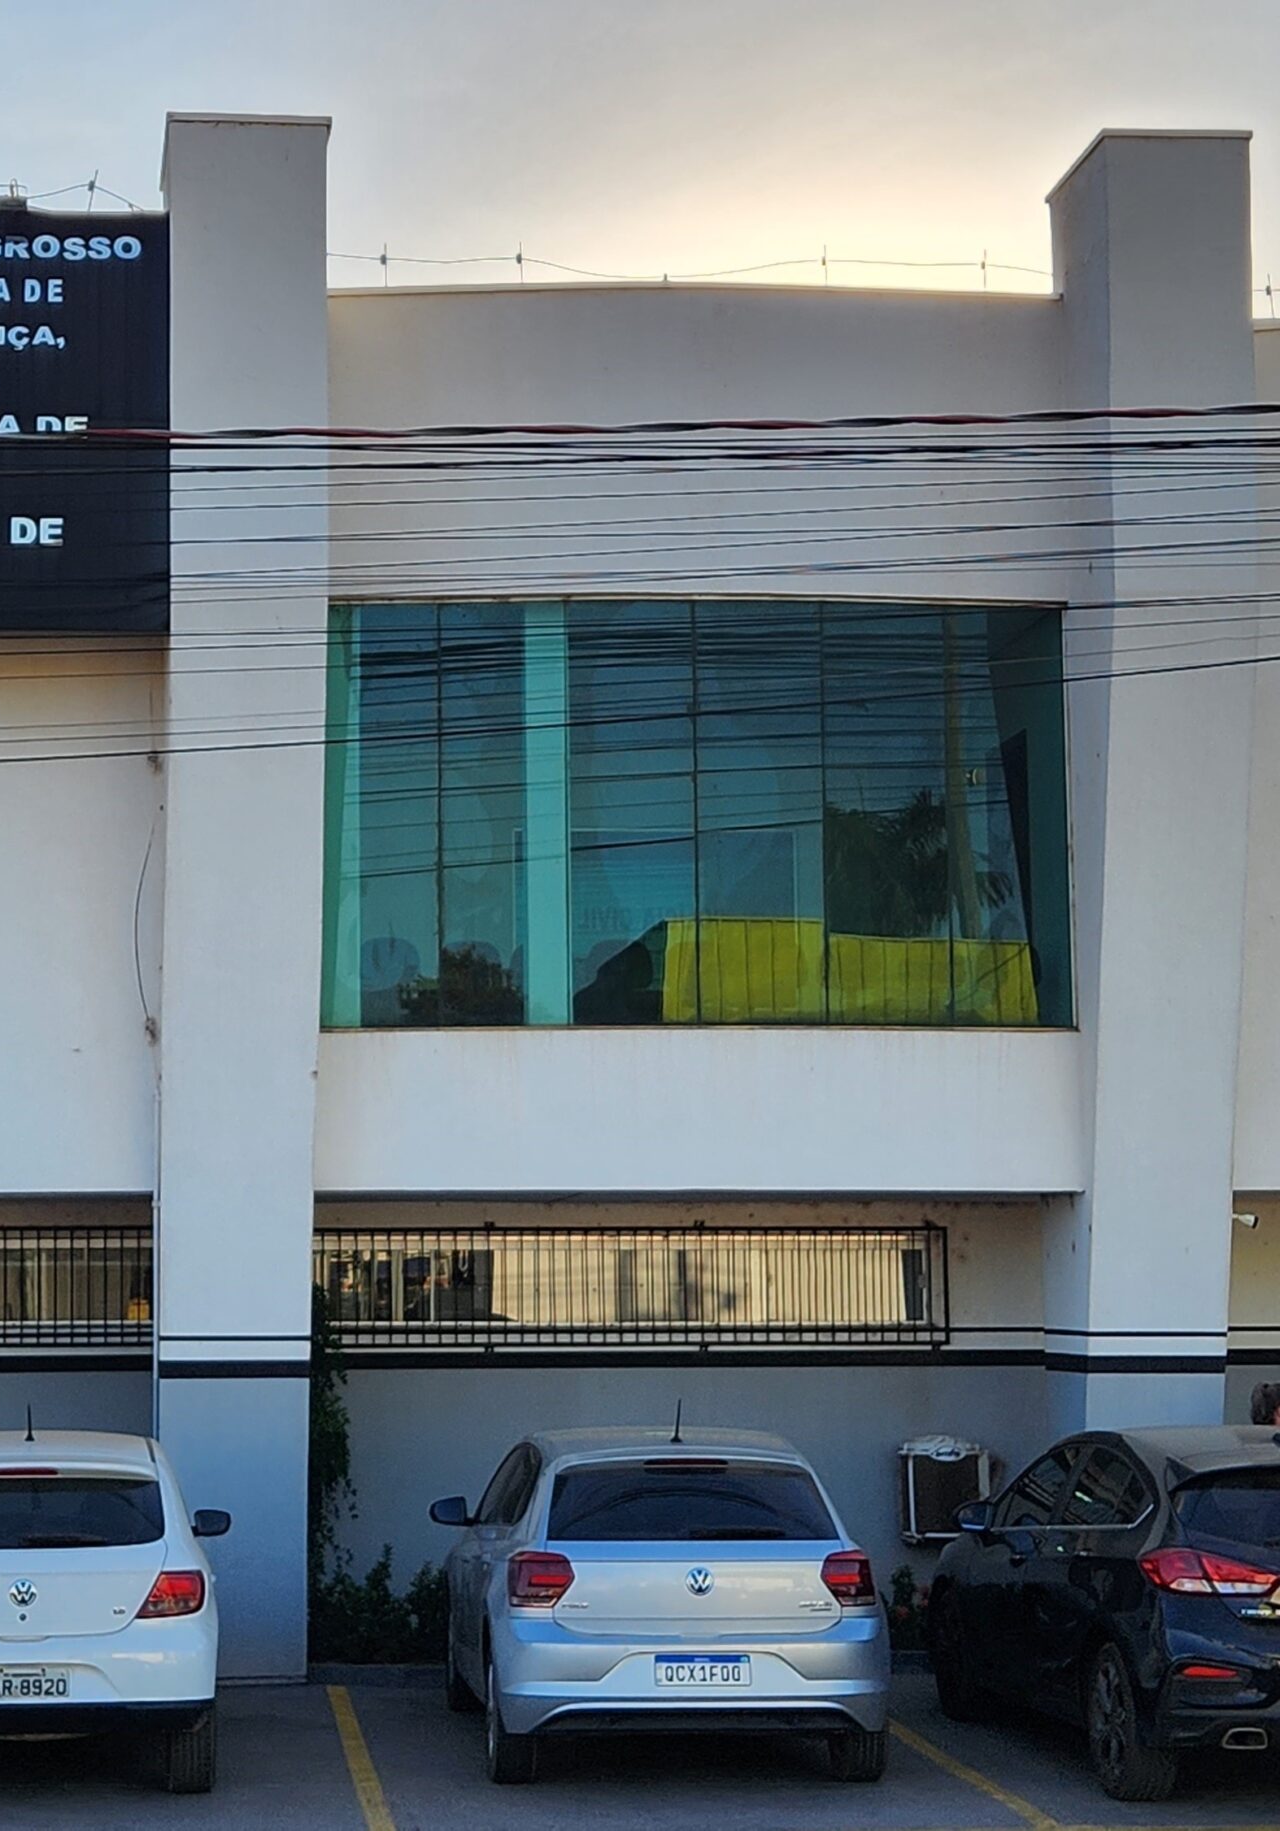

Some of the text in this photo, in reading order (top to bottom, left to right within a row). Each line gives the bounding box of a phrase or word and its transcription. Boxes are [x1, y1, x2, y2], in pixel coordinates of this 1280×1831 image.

[24, 278, 64, 302] DE
[36, 415, 89, 434] DE
[10, 517, 64, 546] DE
